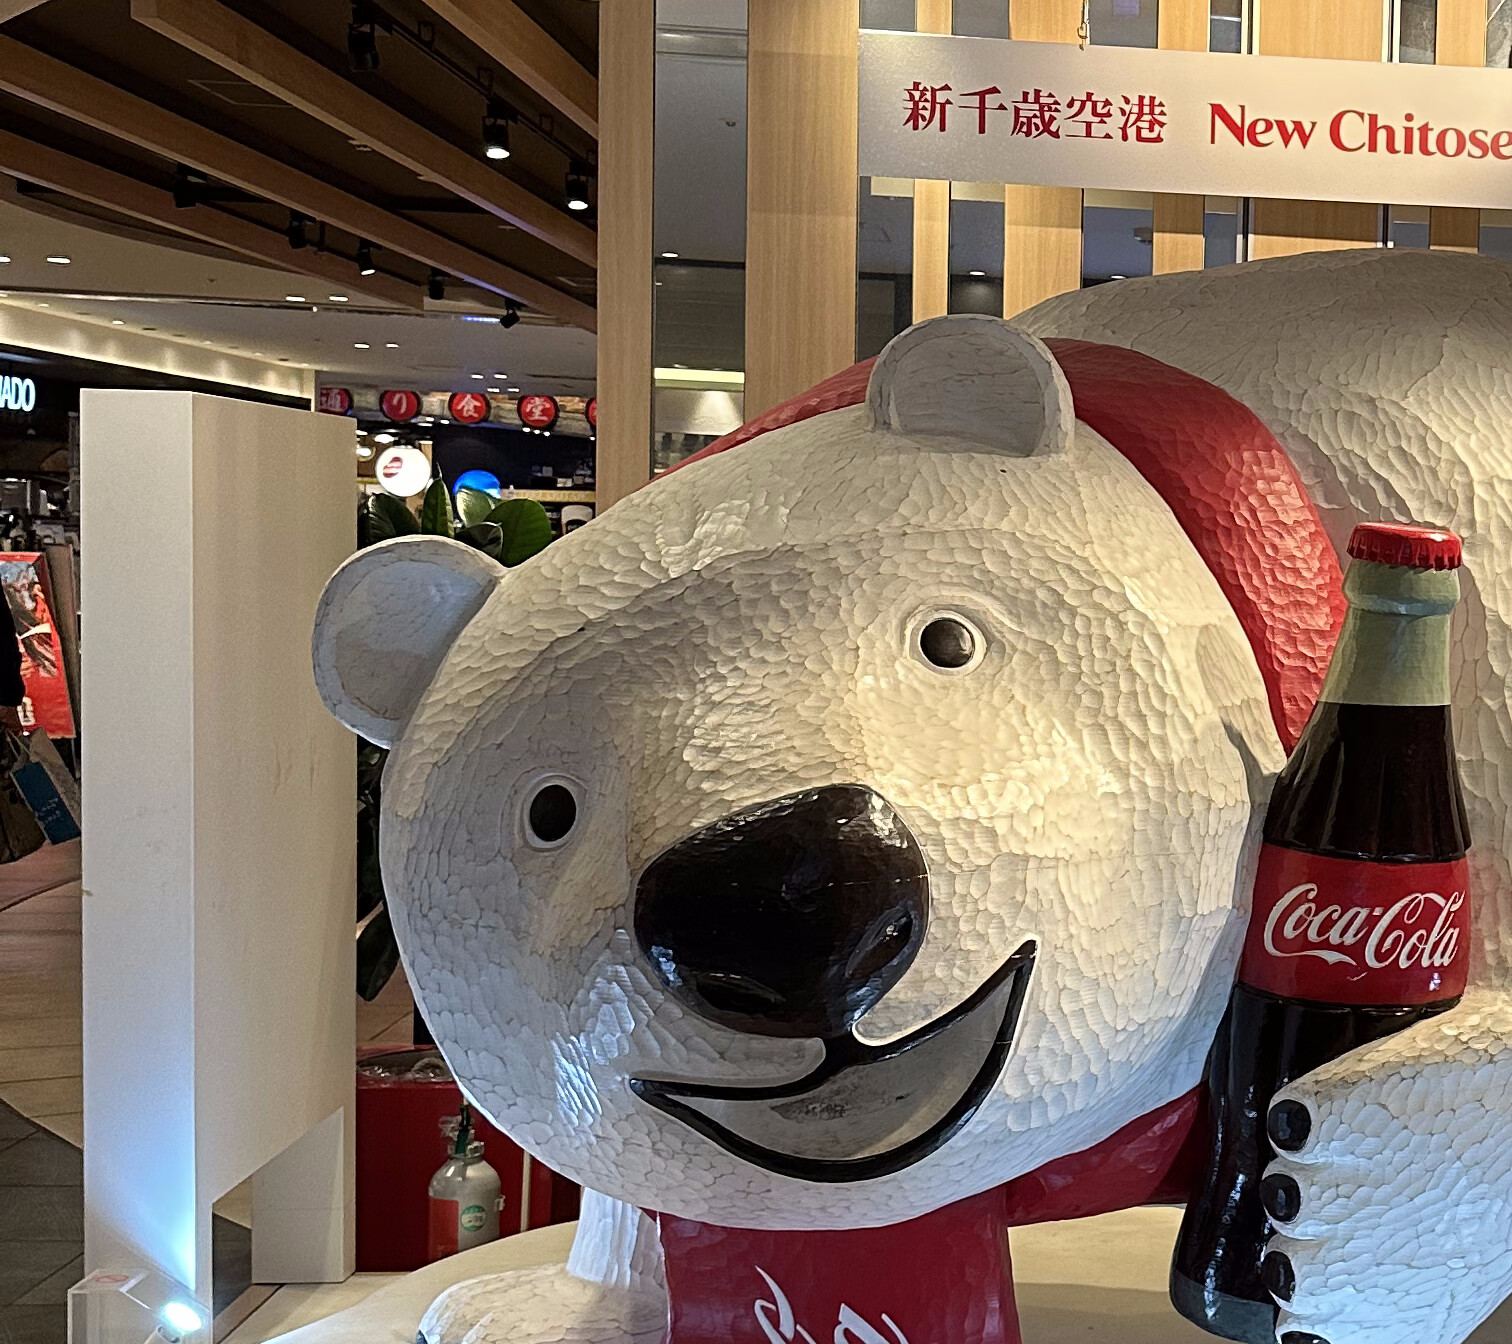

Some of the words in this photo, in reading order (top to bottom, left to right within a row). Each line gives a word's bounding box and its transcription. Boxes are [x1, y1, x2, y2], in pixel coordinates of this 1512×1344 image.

[902, 80, 1168, 144] 新千歳空港
[1208, 101, 1317, 152] New
[0, 374, 36, 412] ADO
[1263, 882, 1467, 969] Coca-Cola
